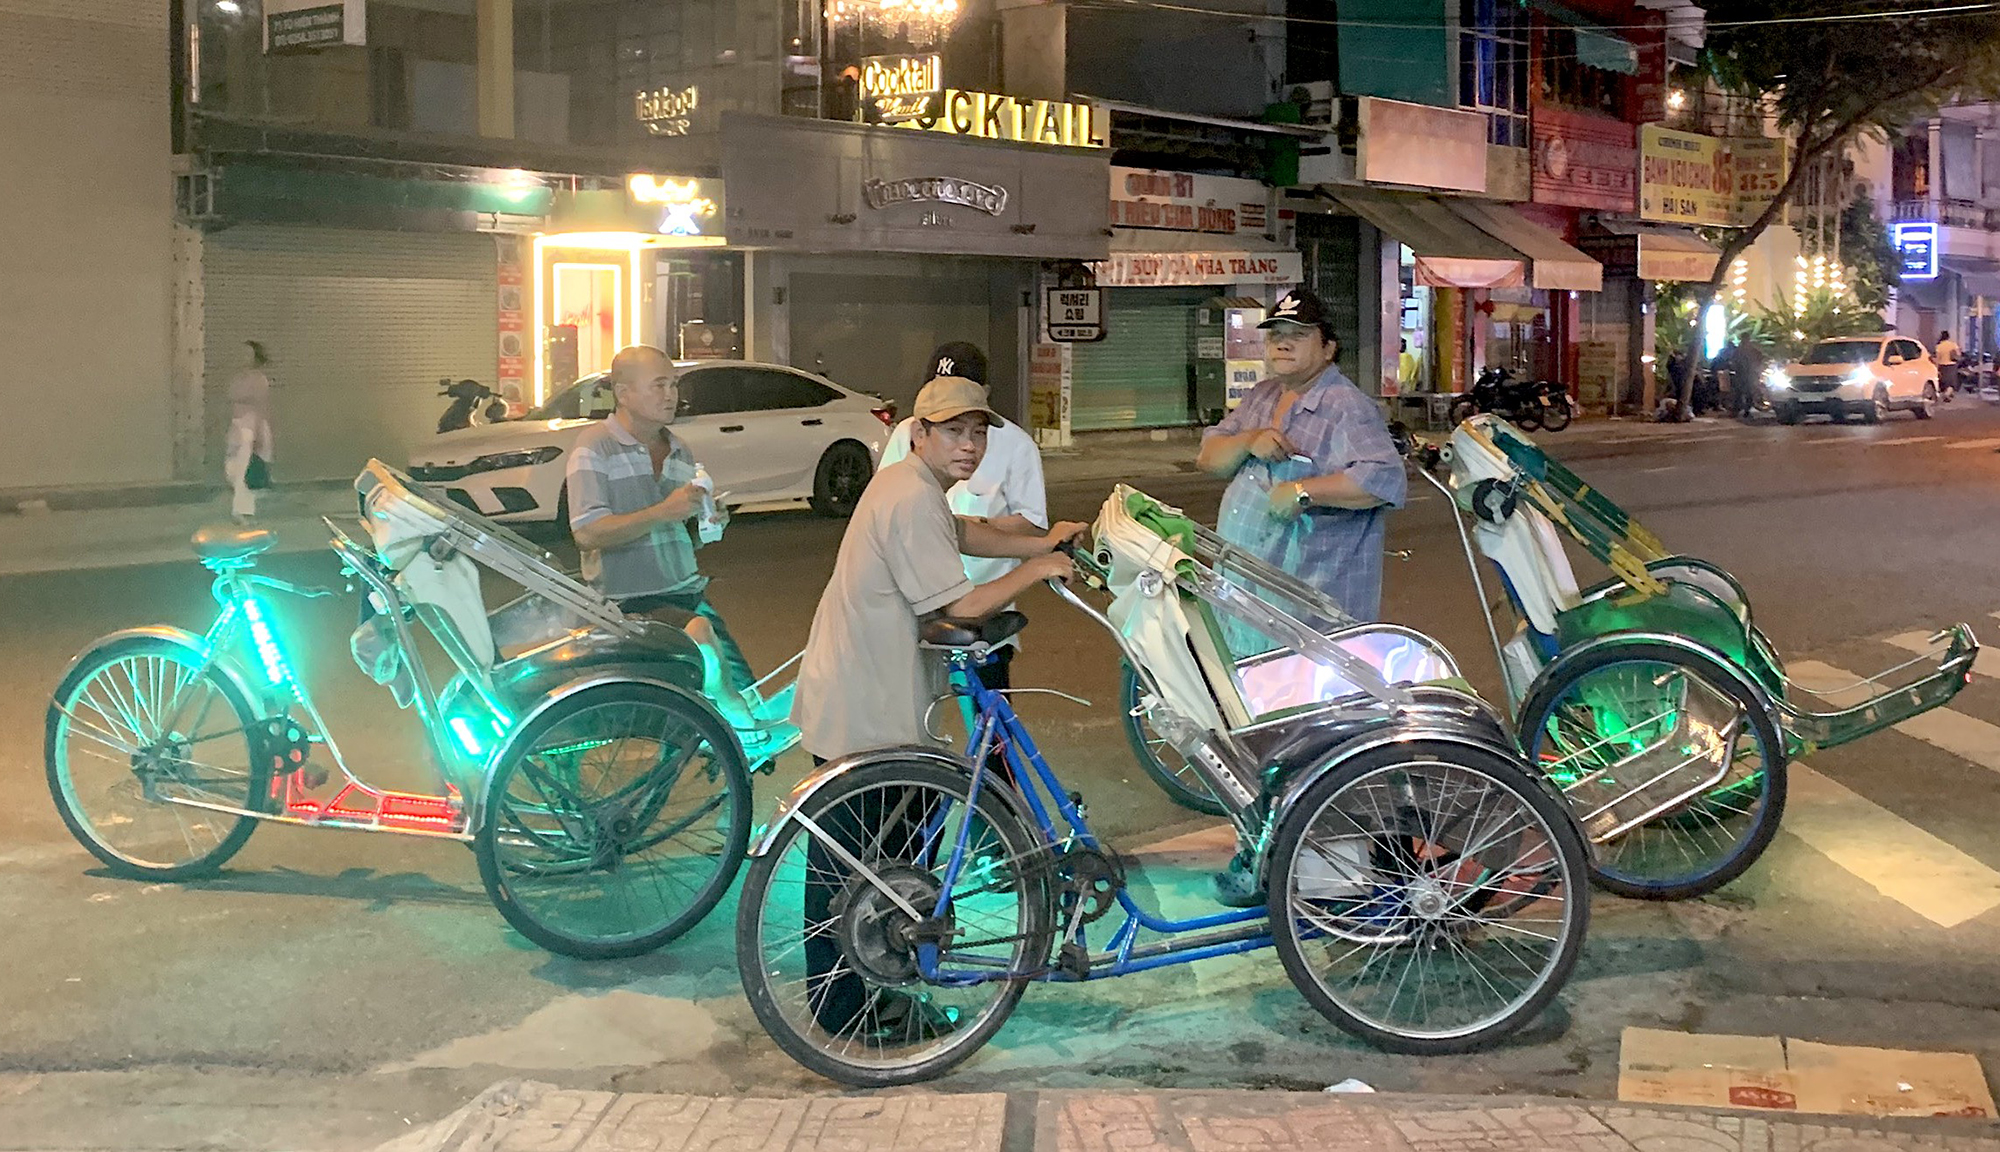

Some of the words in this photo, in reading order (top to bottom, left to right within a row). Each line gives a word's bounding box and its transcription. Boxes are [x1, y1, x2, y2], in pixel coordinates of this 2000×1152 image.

[865, 55, 941, 96] Cocktail
[886, 90, 1105, 147] CKTAIL
[1194, 258, 1225, 276] NHA
[1228, 258, 1278, 275] TRANG
[936, 357, 955, 376] NY
